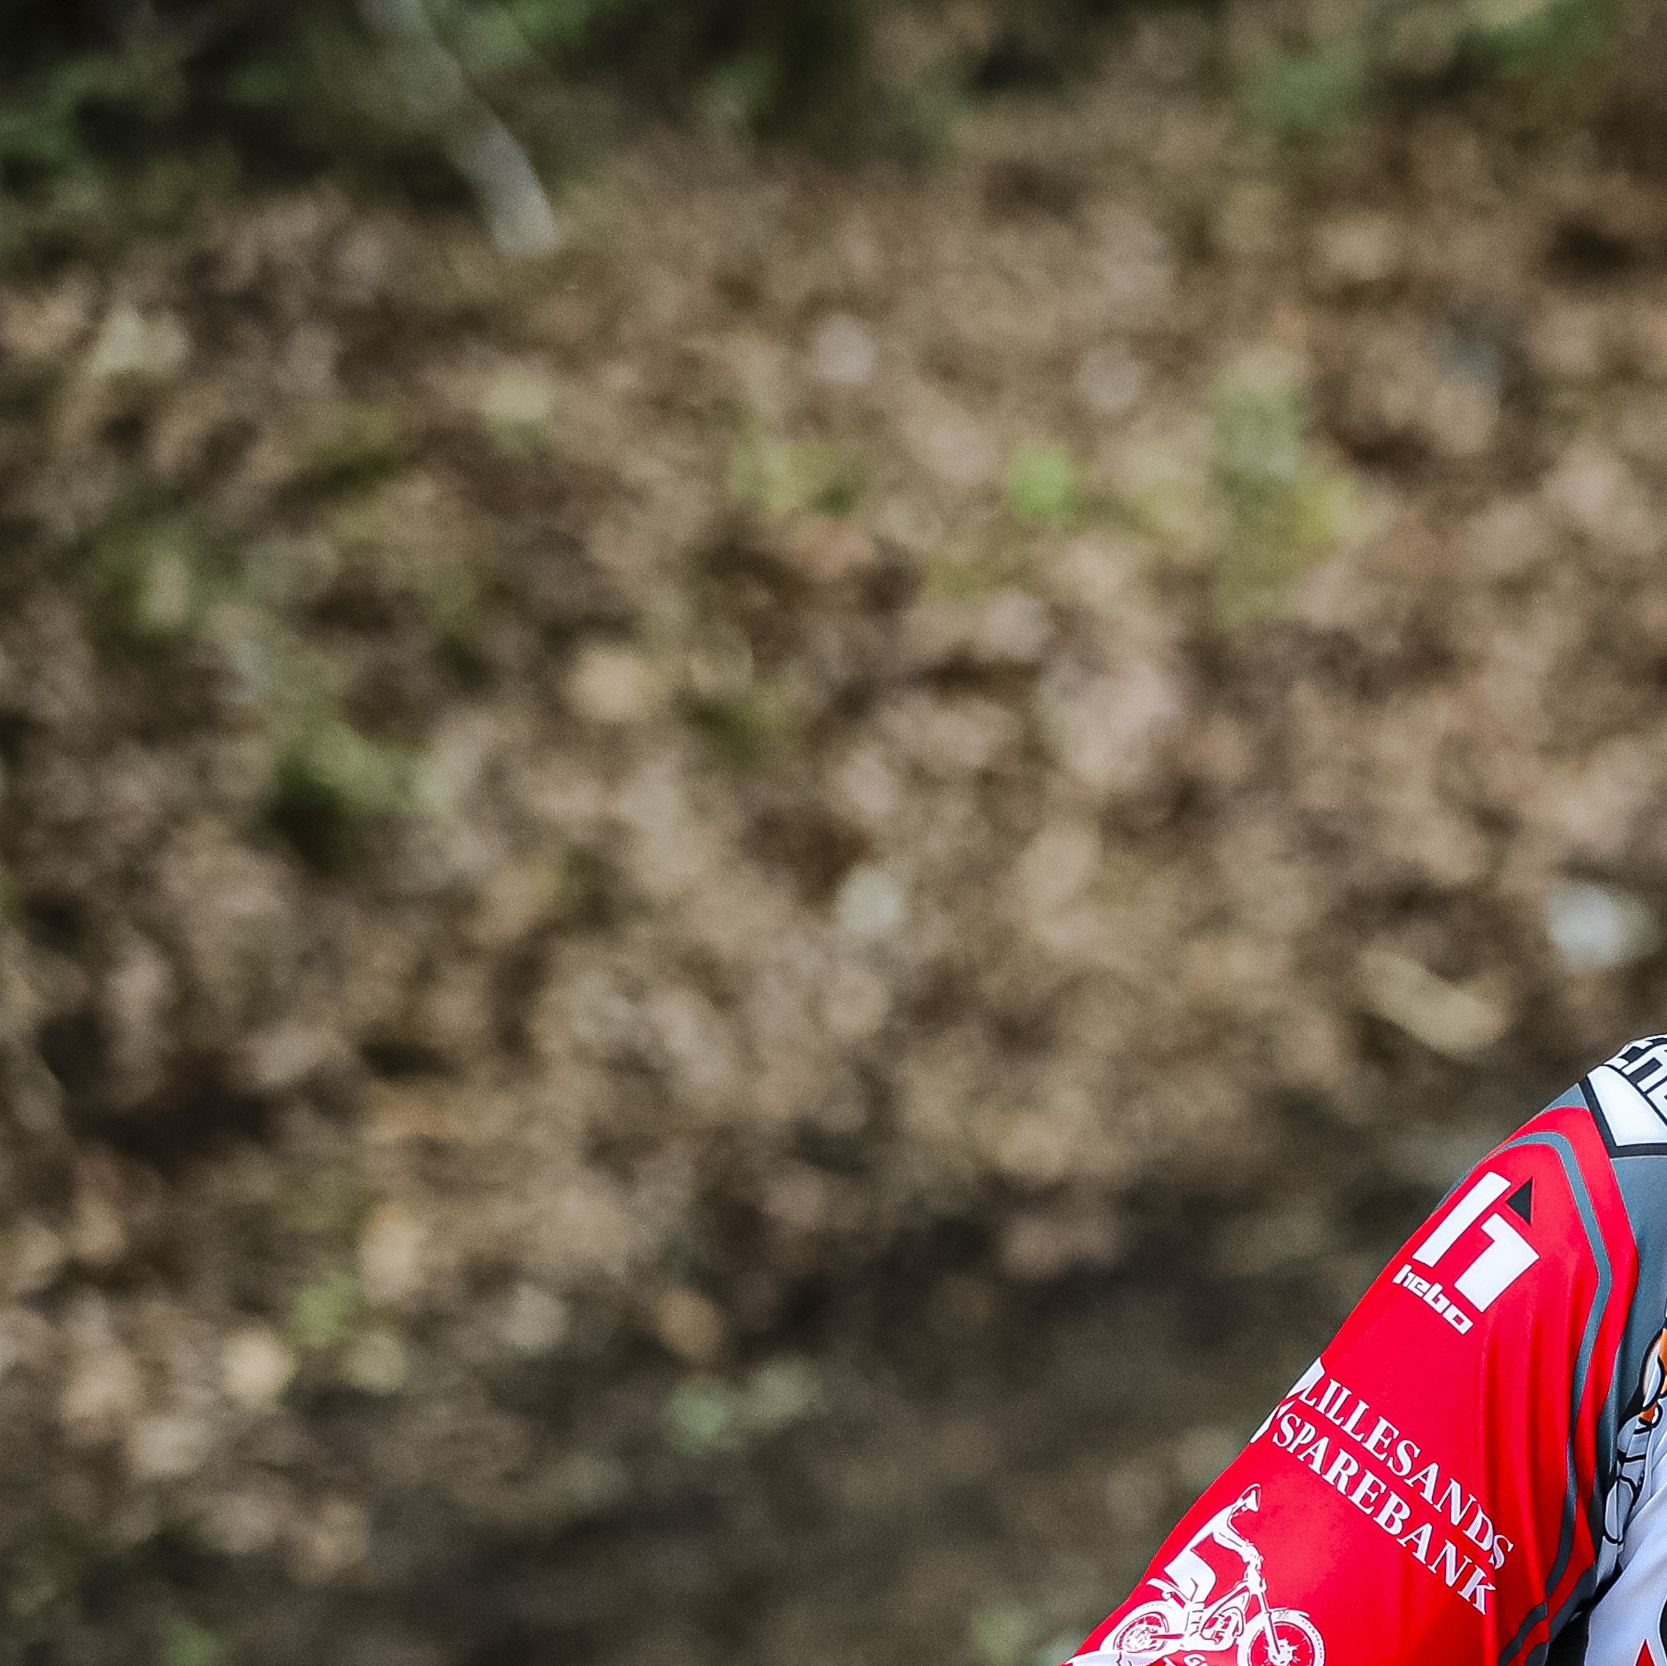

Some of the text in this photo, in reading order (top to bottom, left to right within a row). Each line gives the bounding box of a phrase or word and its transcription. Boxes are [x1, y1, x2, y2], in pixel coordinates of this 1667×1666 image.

[1392, 1263, 1474, 1335] hebo
[1272, 1412, 1497, 1616] SPAREBANK
[1298, 1378, 1514, 1570] LILLESANDS
